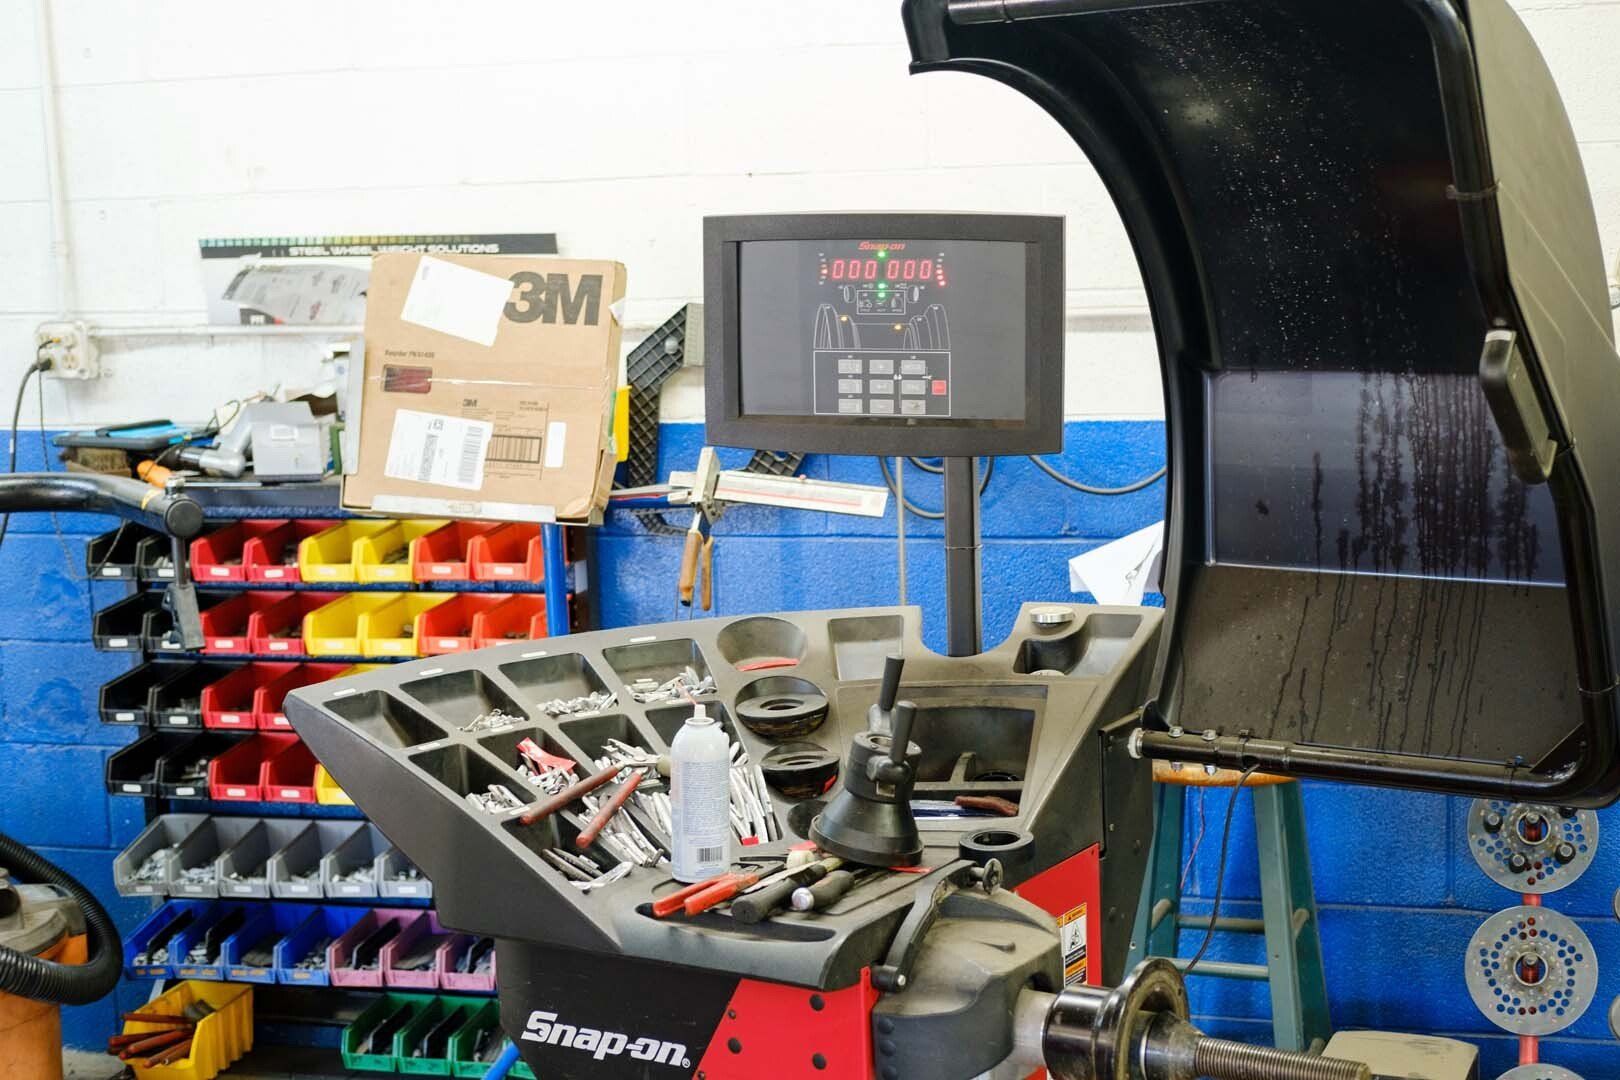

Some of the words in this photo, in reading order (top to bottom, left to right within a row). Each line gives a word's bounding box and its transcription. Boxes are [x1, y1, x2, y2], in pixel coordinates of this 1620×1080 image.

[289, 247, 329, 256] STEEL
[331, 246, 373, 255] WHEEL
[427, 244, 499, 254] SOLUTIONS
[832, 259, 877, 279] 000
[887, 259, 932, 279] 000
[503, 271, 603, 325] 3M
[463, 399, 477, 407] 3M
